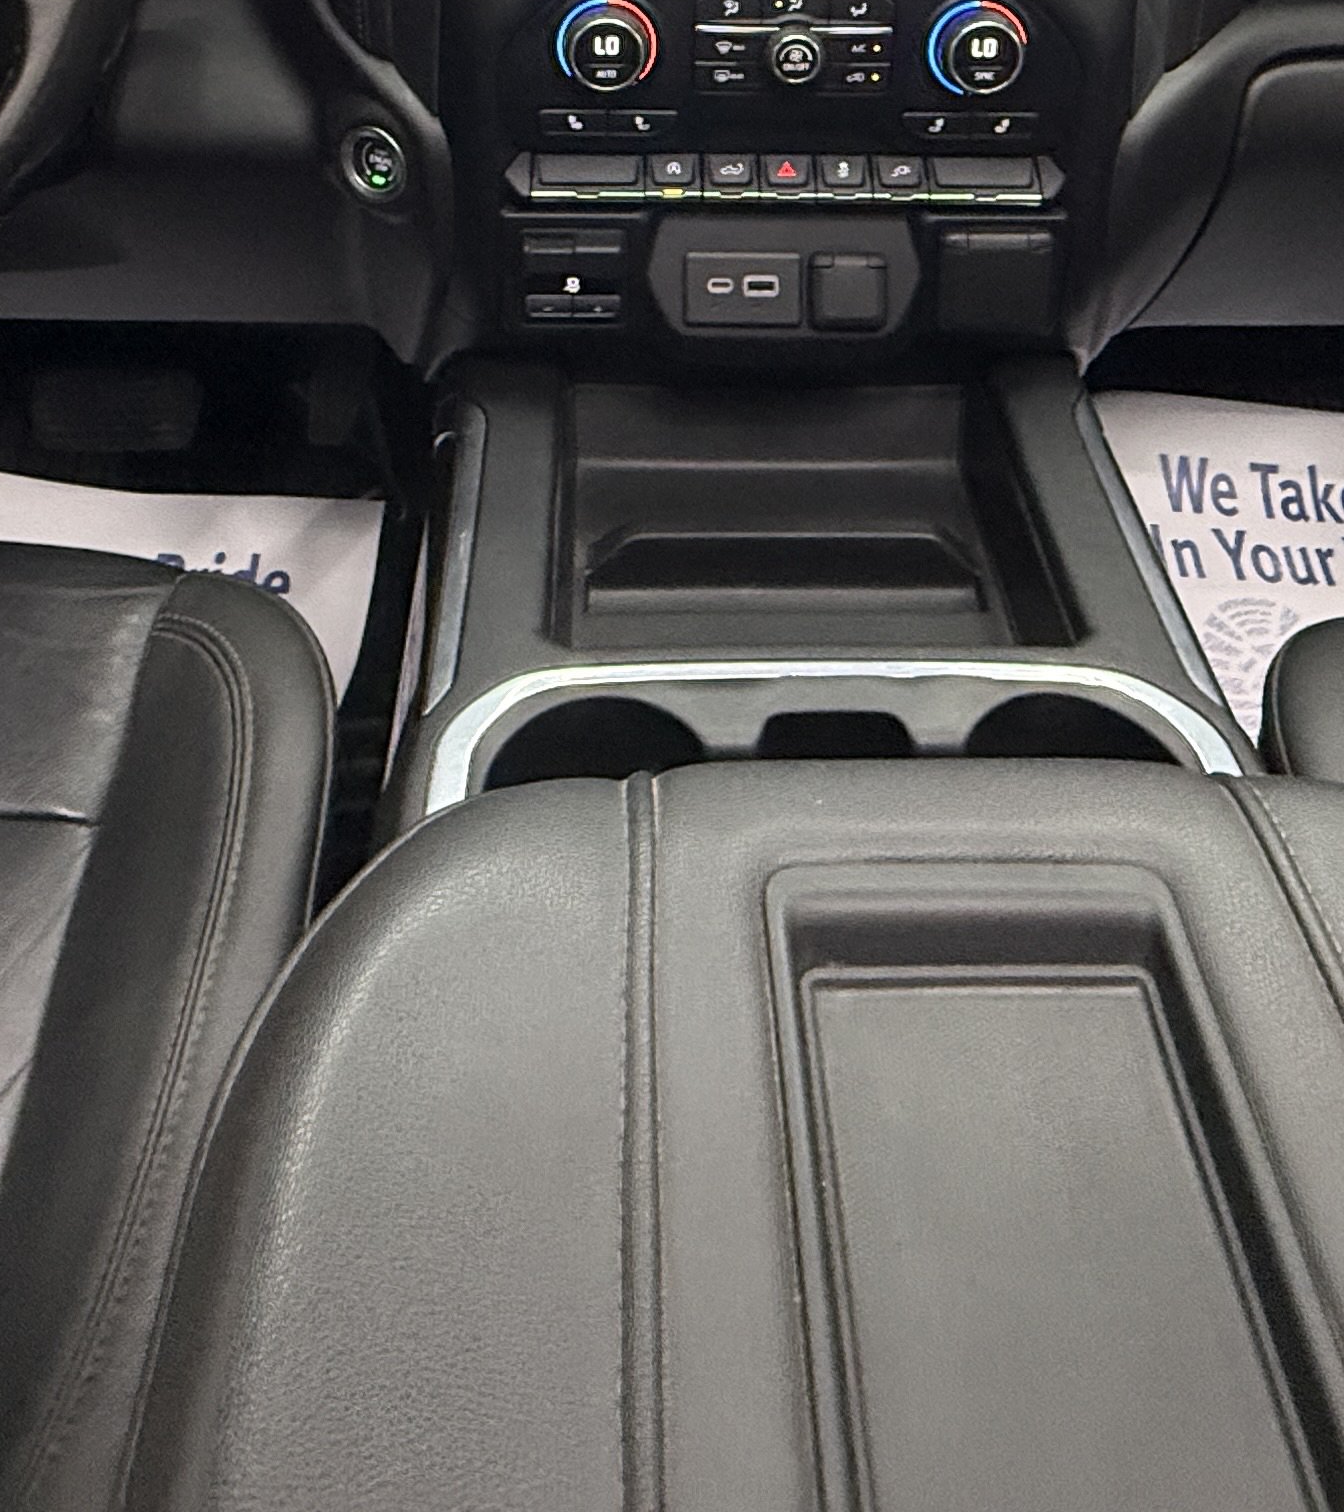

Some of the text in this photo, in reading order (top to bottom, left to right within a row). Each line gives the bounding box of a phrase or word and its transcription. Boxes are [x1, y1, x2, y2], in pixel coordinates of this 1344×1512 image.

[594, 36, 620, 55] LO
[971, 38, 999, 58] LO
[595, 70, 617, 79] AUTO
[974, 71, 996, 81] SYNC
[1159, 453, 1239, 517] We
[1150, 523, 1207, 579] In
[1210, 527, 1336, 586] Your
